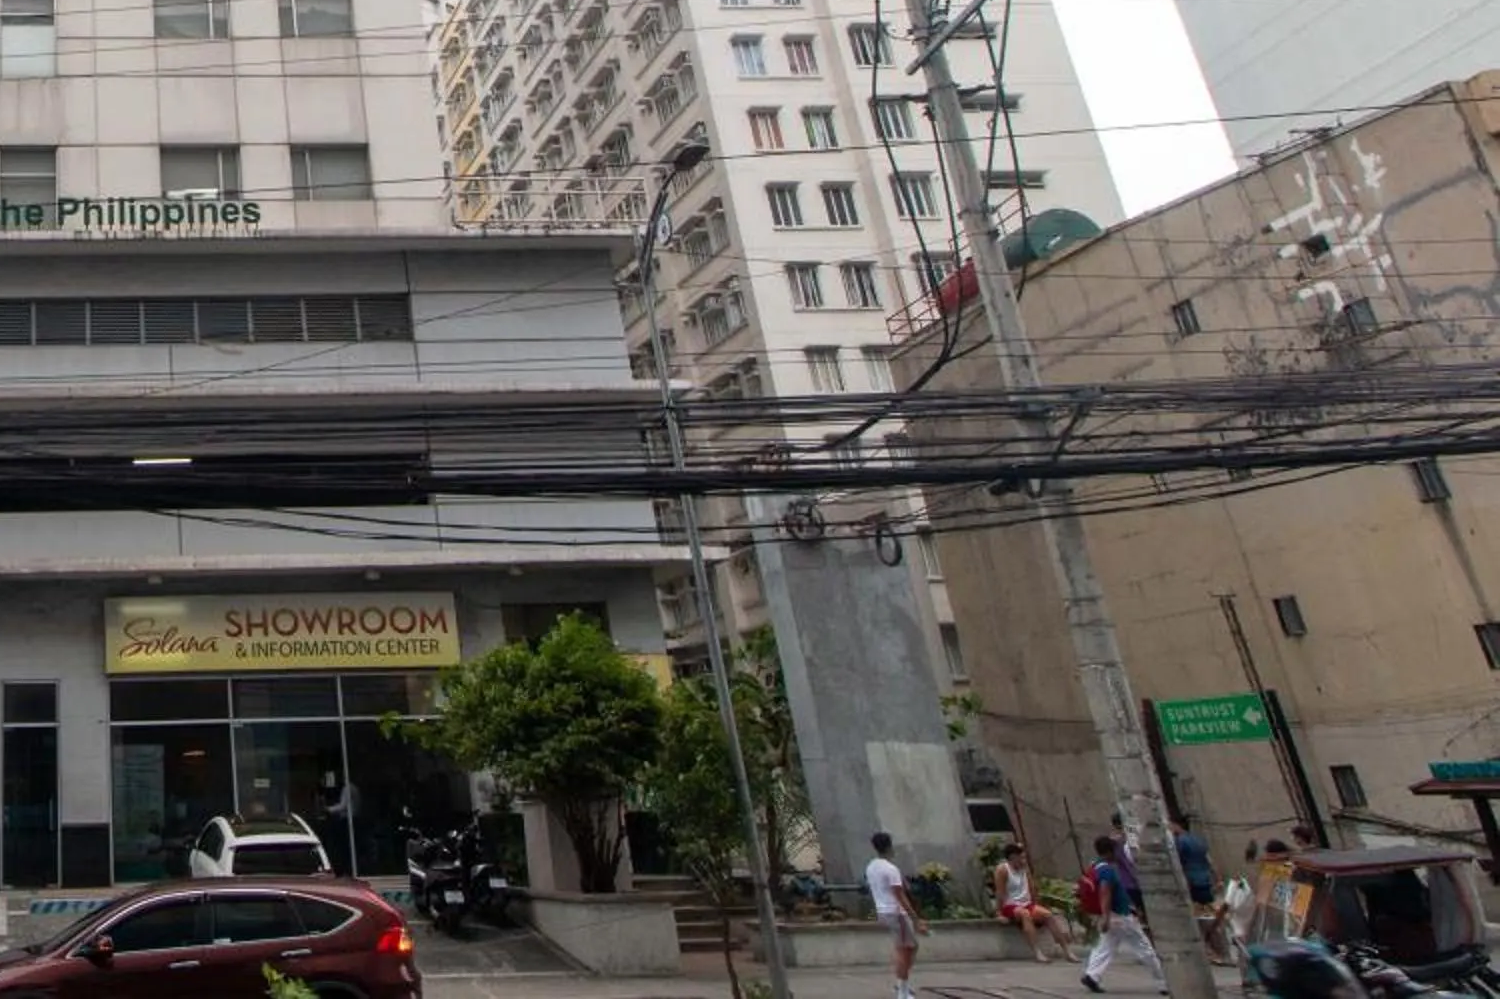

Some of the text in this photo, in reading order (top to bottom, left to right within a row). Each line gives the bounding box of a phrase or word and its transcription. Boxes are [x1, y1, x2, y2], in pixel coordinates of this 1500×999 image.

[56, 197, 261, 232] Philippines
[119, 617, 221, 659] Solana
[224, 604, 449, 639] SHOWROOM
[235, 637, 440, 658] & INFORMATION CENTER
[1166, 703, 1237, 719] SUNTRUST
